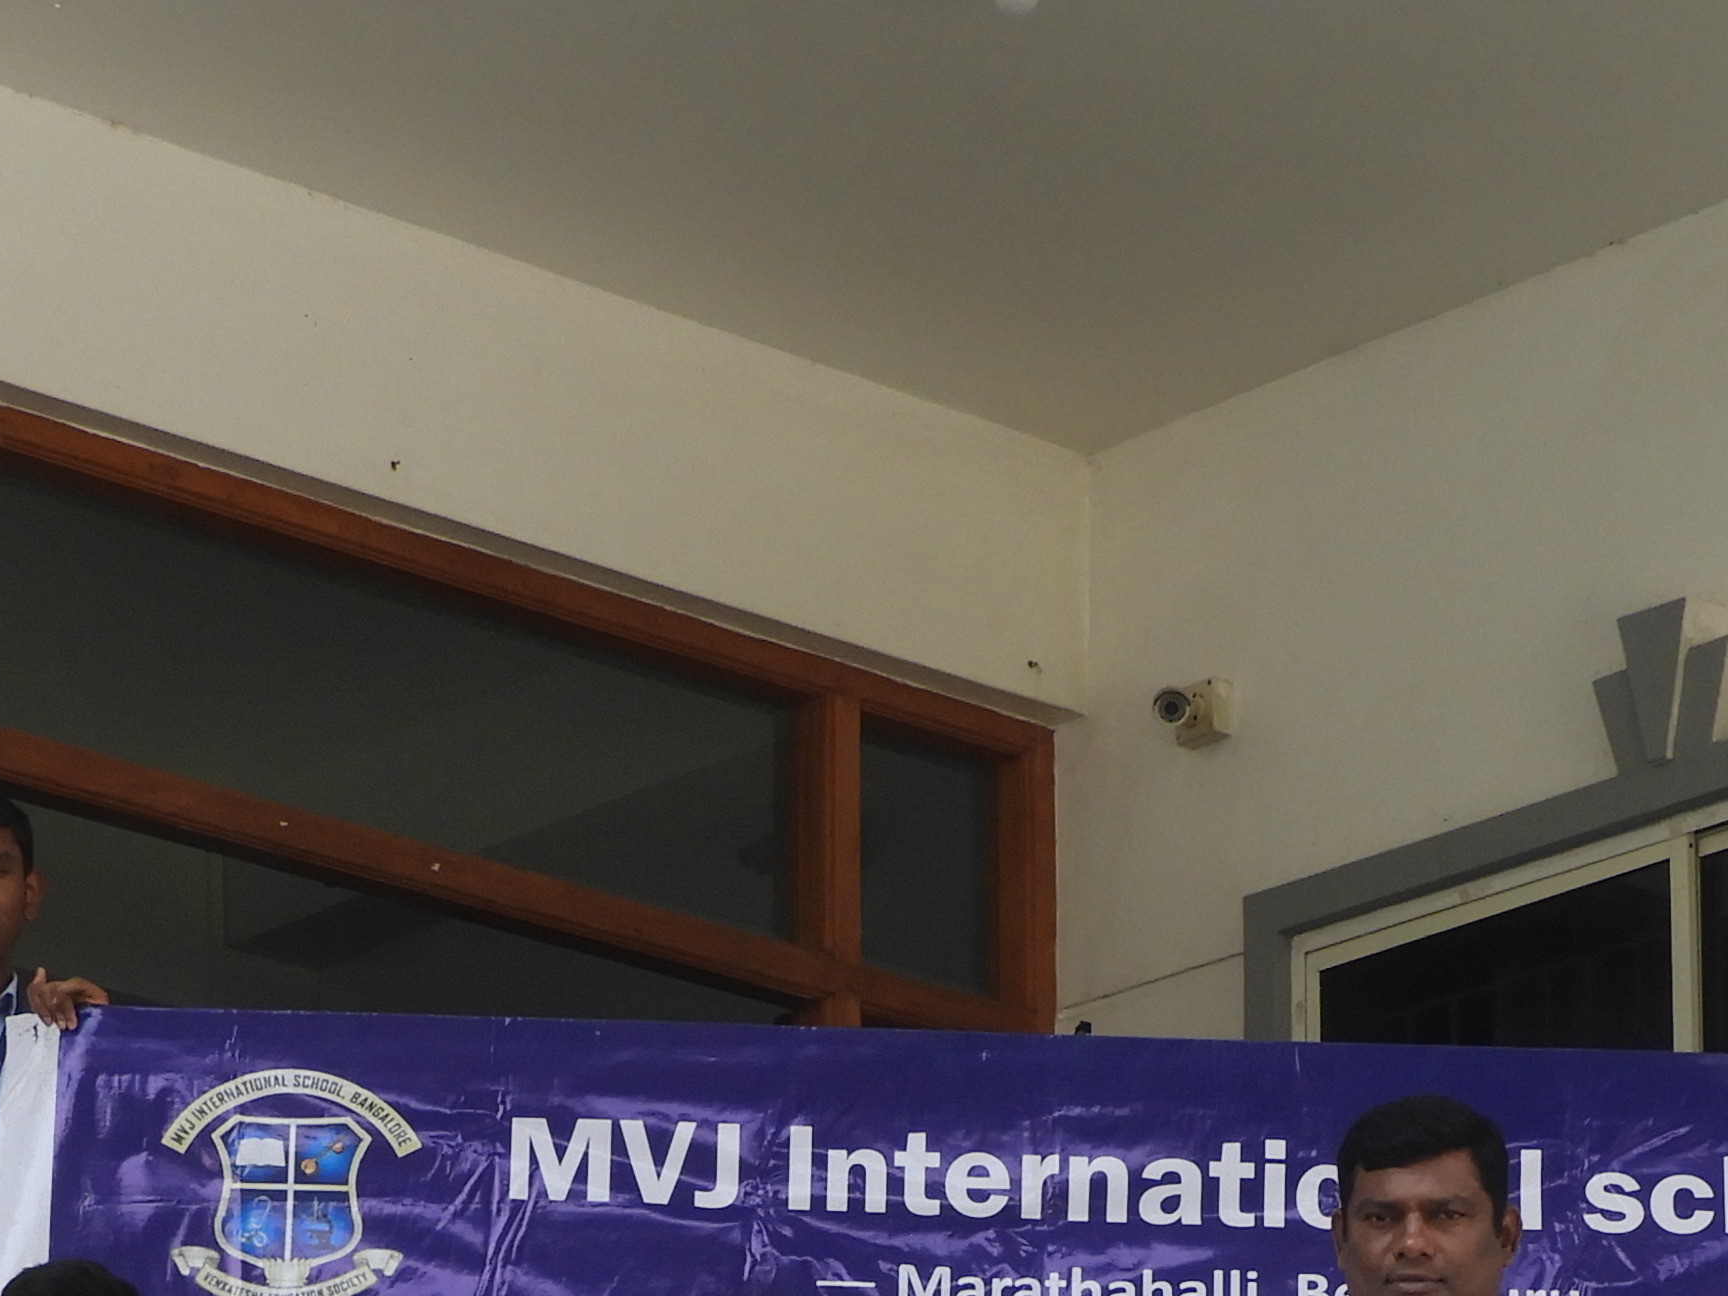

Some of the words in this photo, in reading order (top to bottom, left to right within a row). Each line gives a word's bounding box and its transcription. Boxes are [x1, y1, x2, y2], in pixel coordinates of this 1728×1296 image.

[171, 1118, 196, 1145] MVJ
[194, 1074, 289, 1123] INTERNATIONAL
[349, 1091, 413, 1148] BANGALORE
[508, 1116, 742, 1210] MVJ
[327, 1272, 368, 1296] SOCIETY
